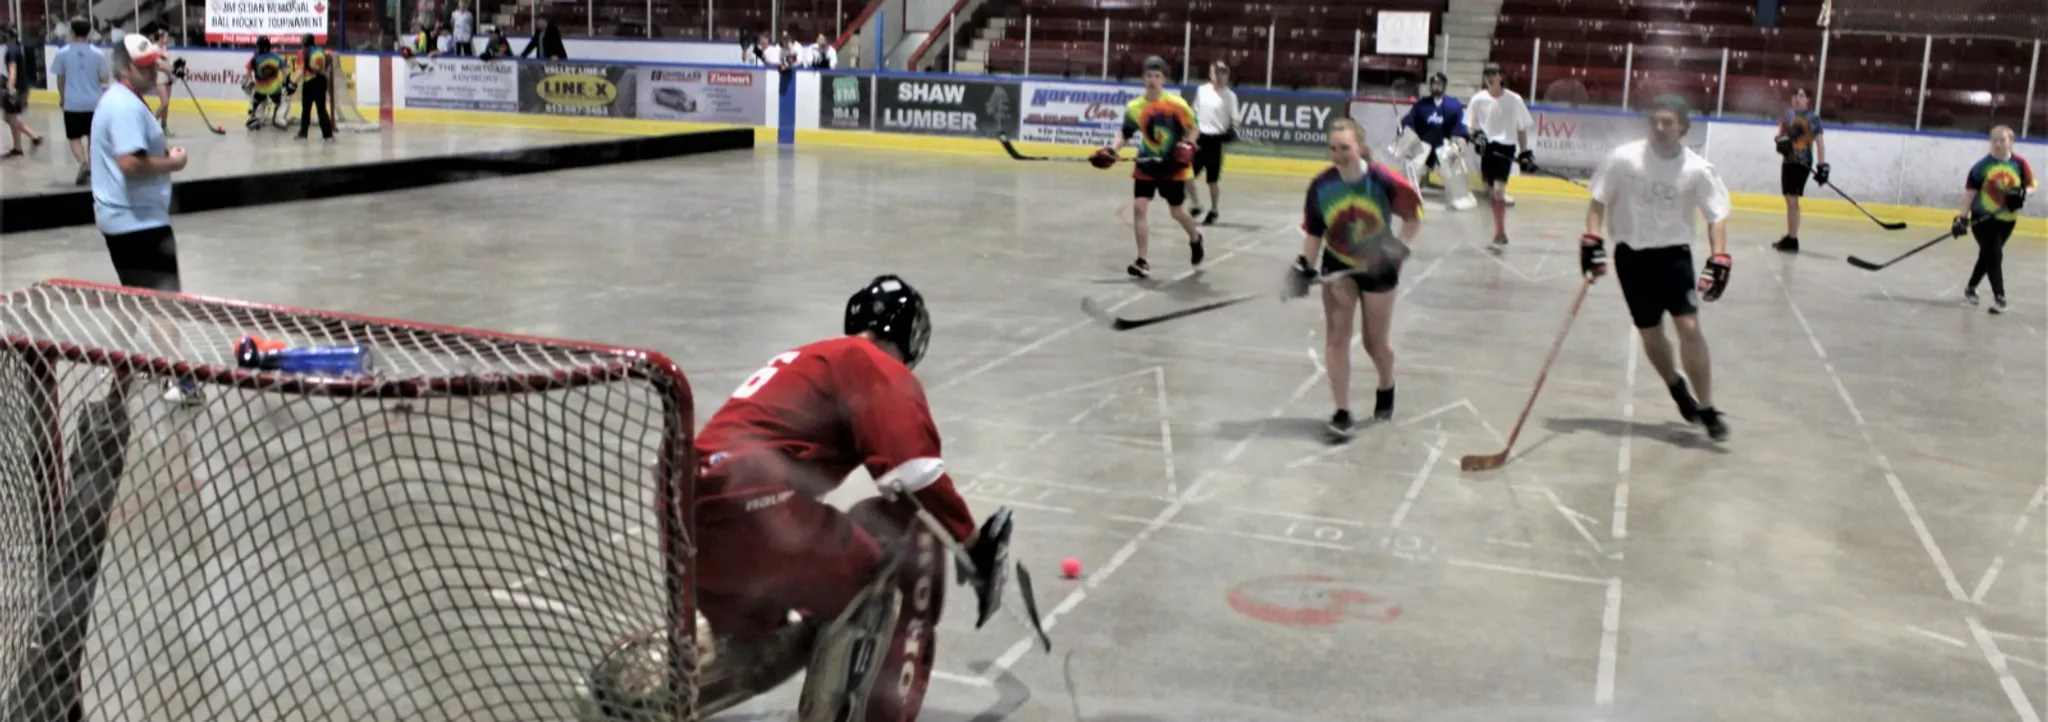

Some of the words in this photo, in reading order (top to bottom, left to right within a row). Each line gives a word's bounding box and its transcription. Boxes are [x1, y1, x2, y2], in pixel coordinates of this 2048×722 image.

[223, 2, 236, 13] JIM
[267, 2, 309, 13] MEMORIAL
[212, 16, 229, 28] BALL
[232, 16, 264, 28] HOCKEY
[268, 16, 323, 28] TOURNAMENT
[439, 63, 454, 72] THE
[461, 63, 512, 73] MORTGAGE
[544, 65, 577, 76] VALLEY
[709, 72, 751, 85] Ziebart
[898, 81, 966, 104] SHAW
[883, 107, 977, 131] LUMBER
[1236, 101, 1331, 130] VALLEY
[1538, 112, 1577, 139] kw
[1283, 131, 1291, 140] &
